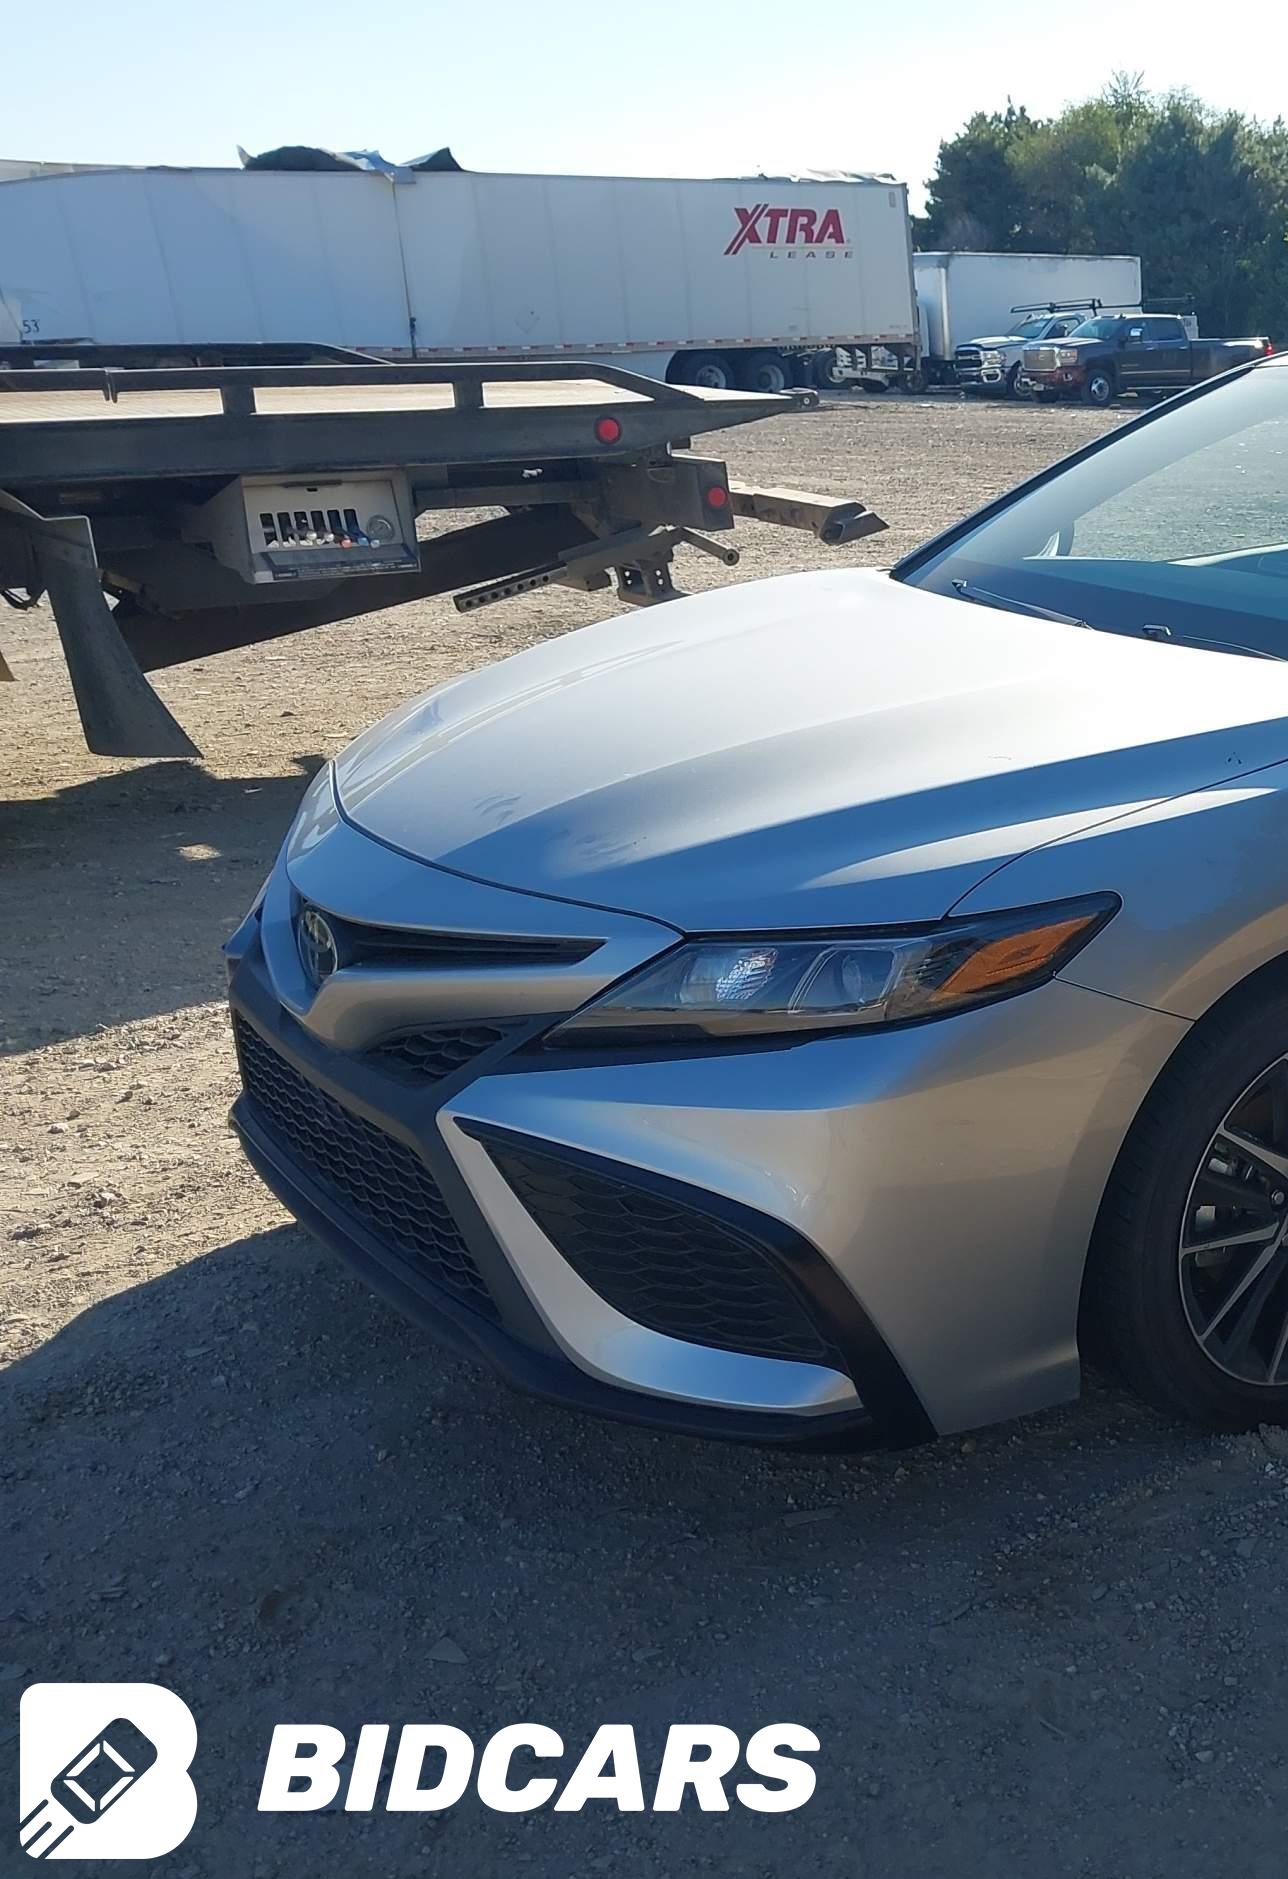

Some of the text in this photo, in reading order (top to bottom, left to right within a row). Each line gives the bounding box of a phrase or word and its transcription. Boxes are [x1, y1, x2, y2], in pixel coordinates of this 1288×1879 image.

[723, 203, 845, 256] XTRA
[769, 250, 853, 259] LEASE
[22, 319, 40, 334] 53
